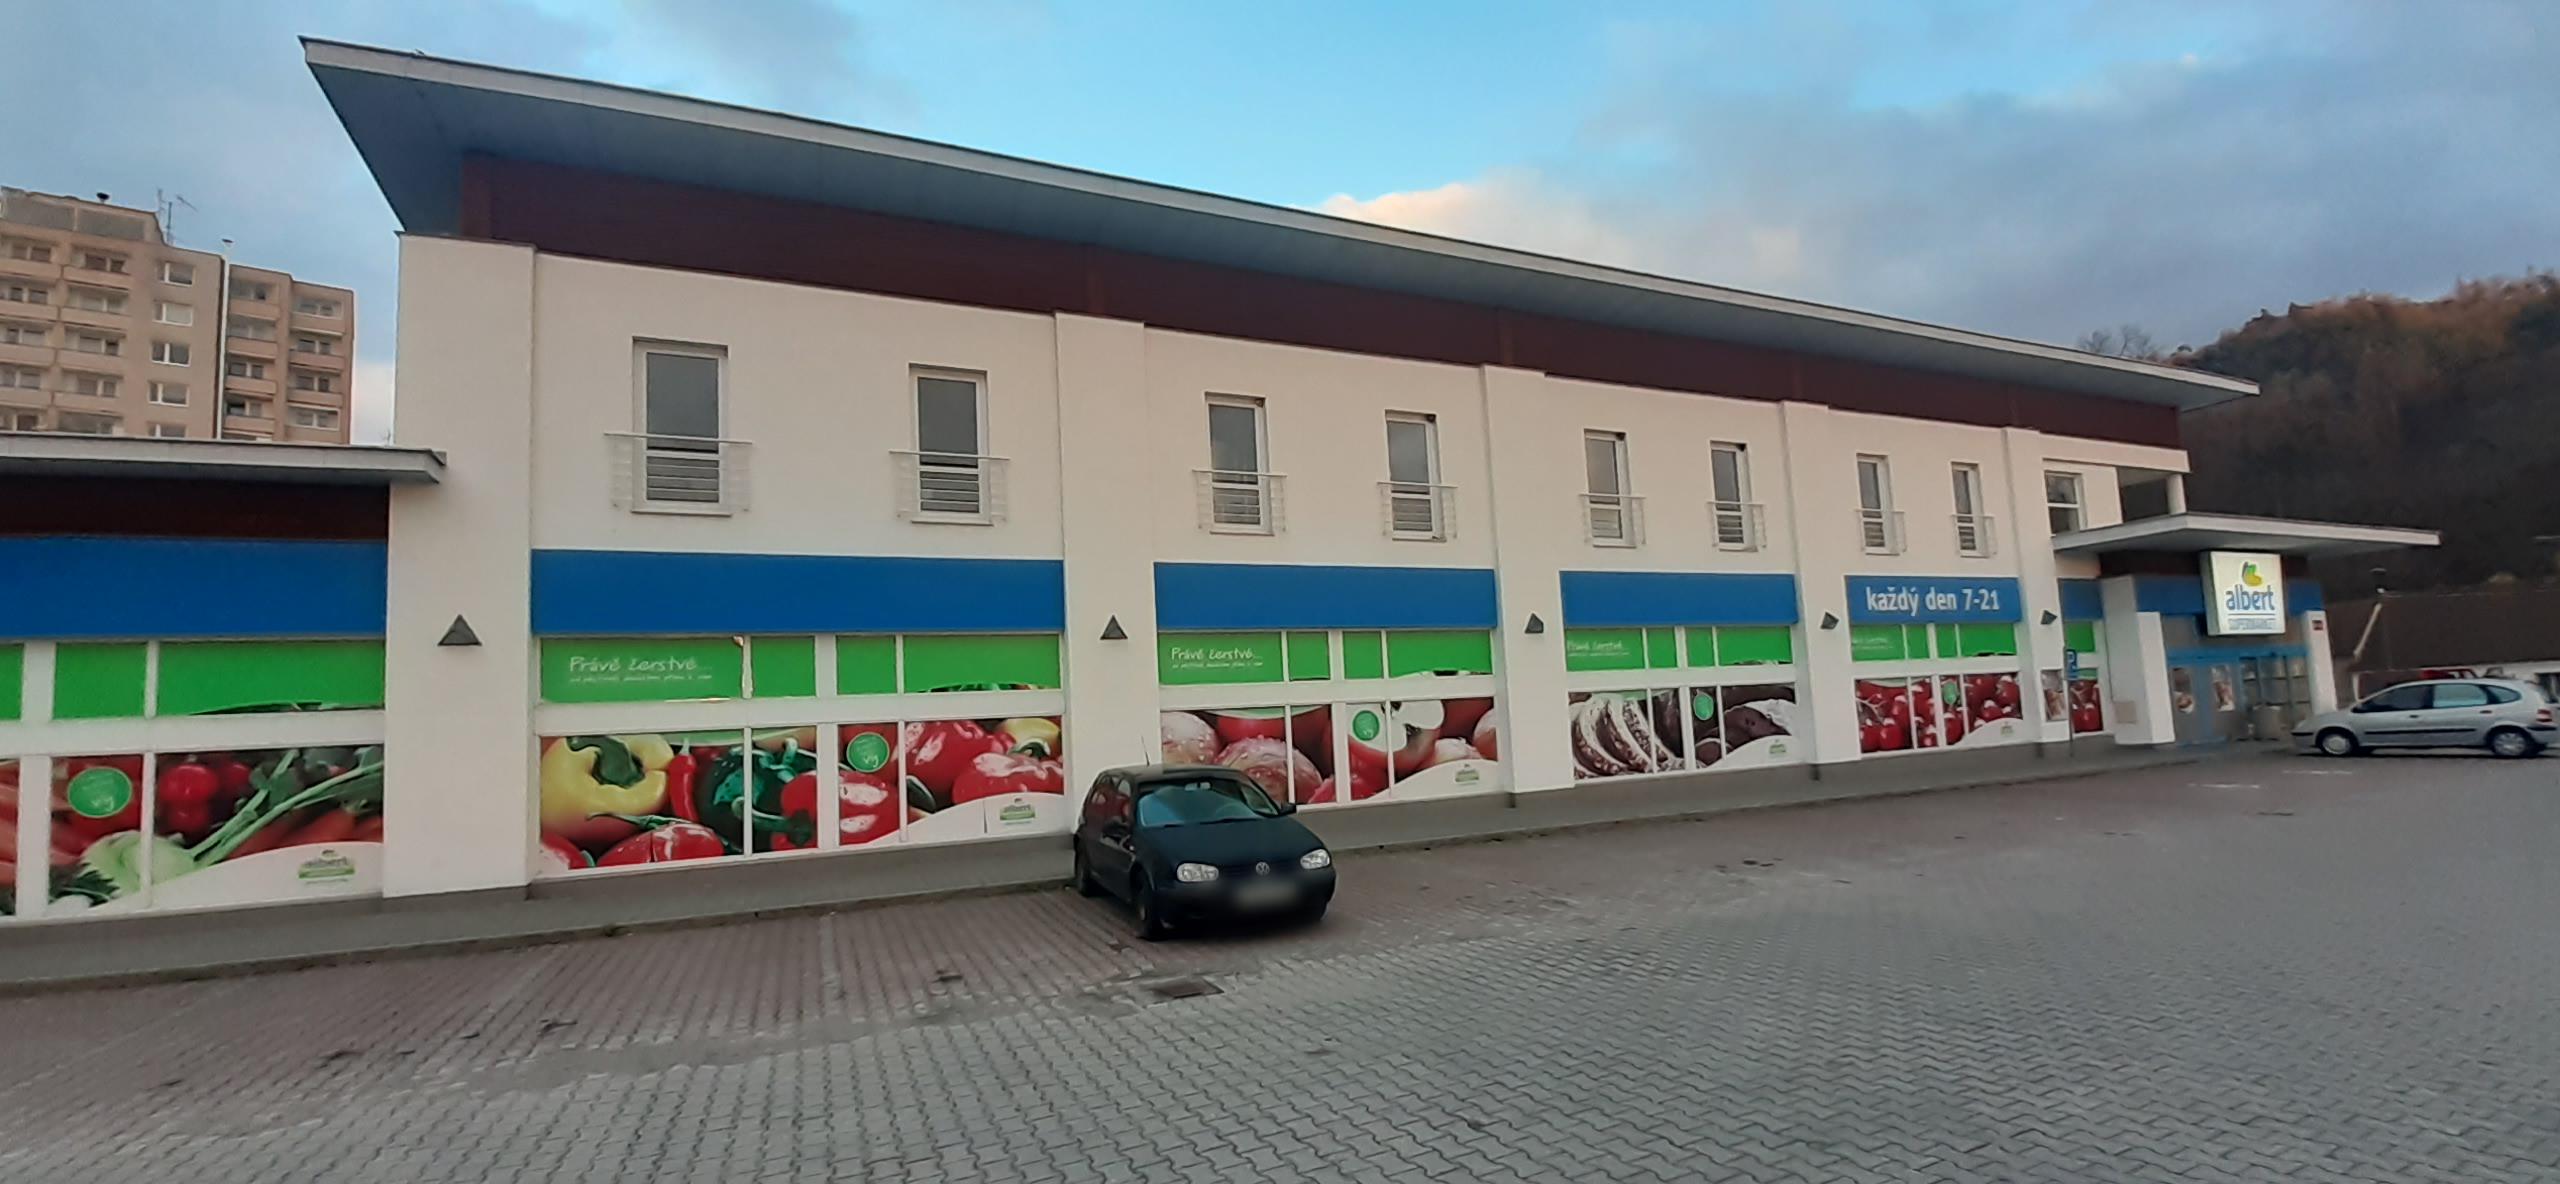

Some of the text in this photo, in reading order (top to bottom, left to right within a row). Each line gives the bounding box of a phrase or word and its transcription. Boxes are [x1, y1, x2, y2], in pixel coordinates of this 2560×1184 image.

[1866, 586, 2000, 617] každý den 7-21
[2226, 584, 2275, 611] albert
